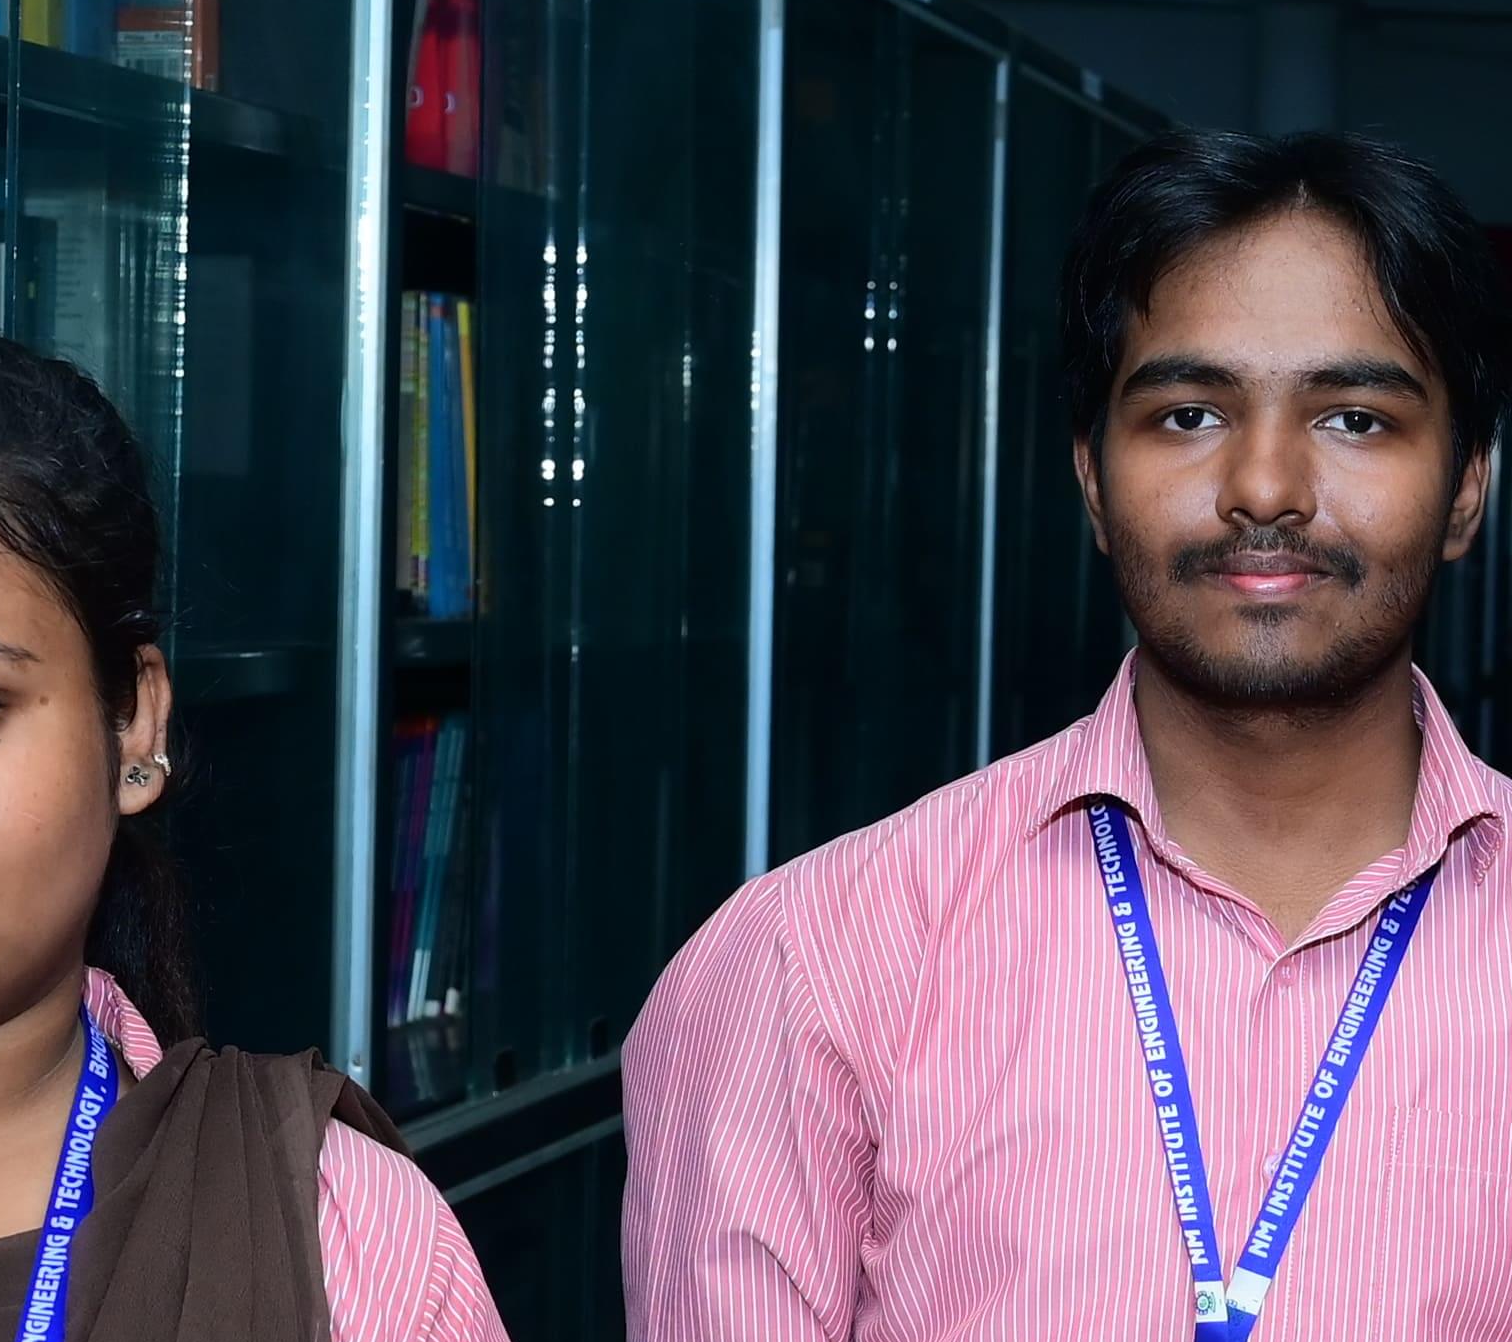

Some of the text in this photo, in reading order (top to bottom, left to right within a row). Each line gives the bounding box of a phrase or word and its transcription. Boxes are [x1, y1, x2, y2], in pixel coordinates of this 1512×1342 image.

[51, 1208, 75, 1230] &
[1111, 901, 1209, 1267] NM INSTITUTE OF ENGINEERING &
[1247, 916, 1402, 1259] NM INSTITUTE OF ENGINEERING &
